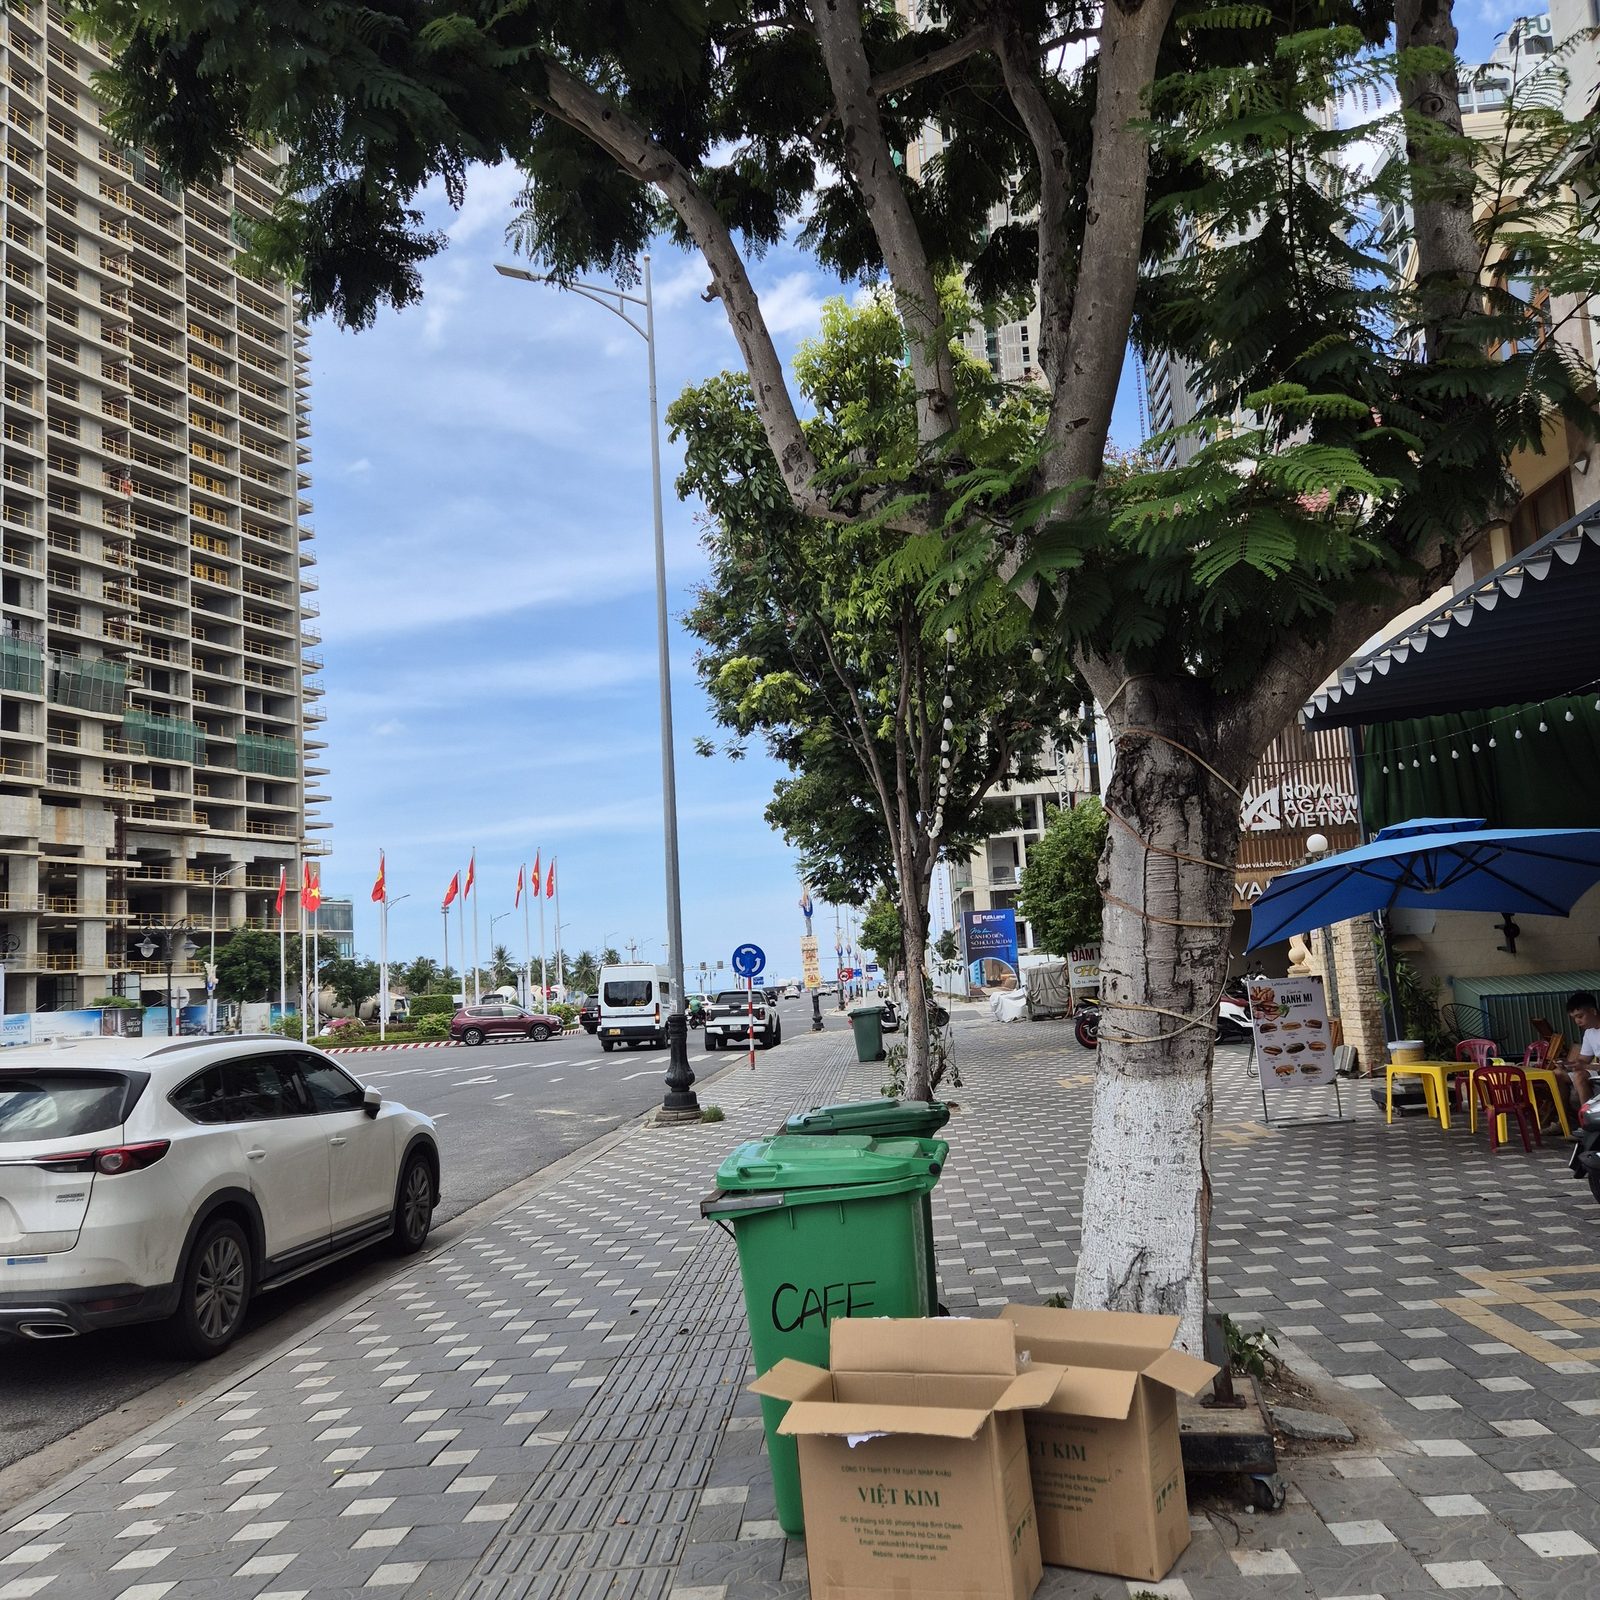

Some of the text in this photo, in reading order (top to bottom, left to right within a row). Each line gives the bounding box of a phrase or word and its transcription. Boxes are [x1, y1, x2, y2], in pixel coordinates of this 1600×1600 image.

[1282, 783, 1348, 800] ROYAL
[1285, 810, 1358, 828] VIETNA
[1234, 880, 1271, 901] YA
[1053, 1442, 1086, 1461] KIM
[858, 1483, 940, 1508] VIỆT KIM
